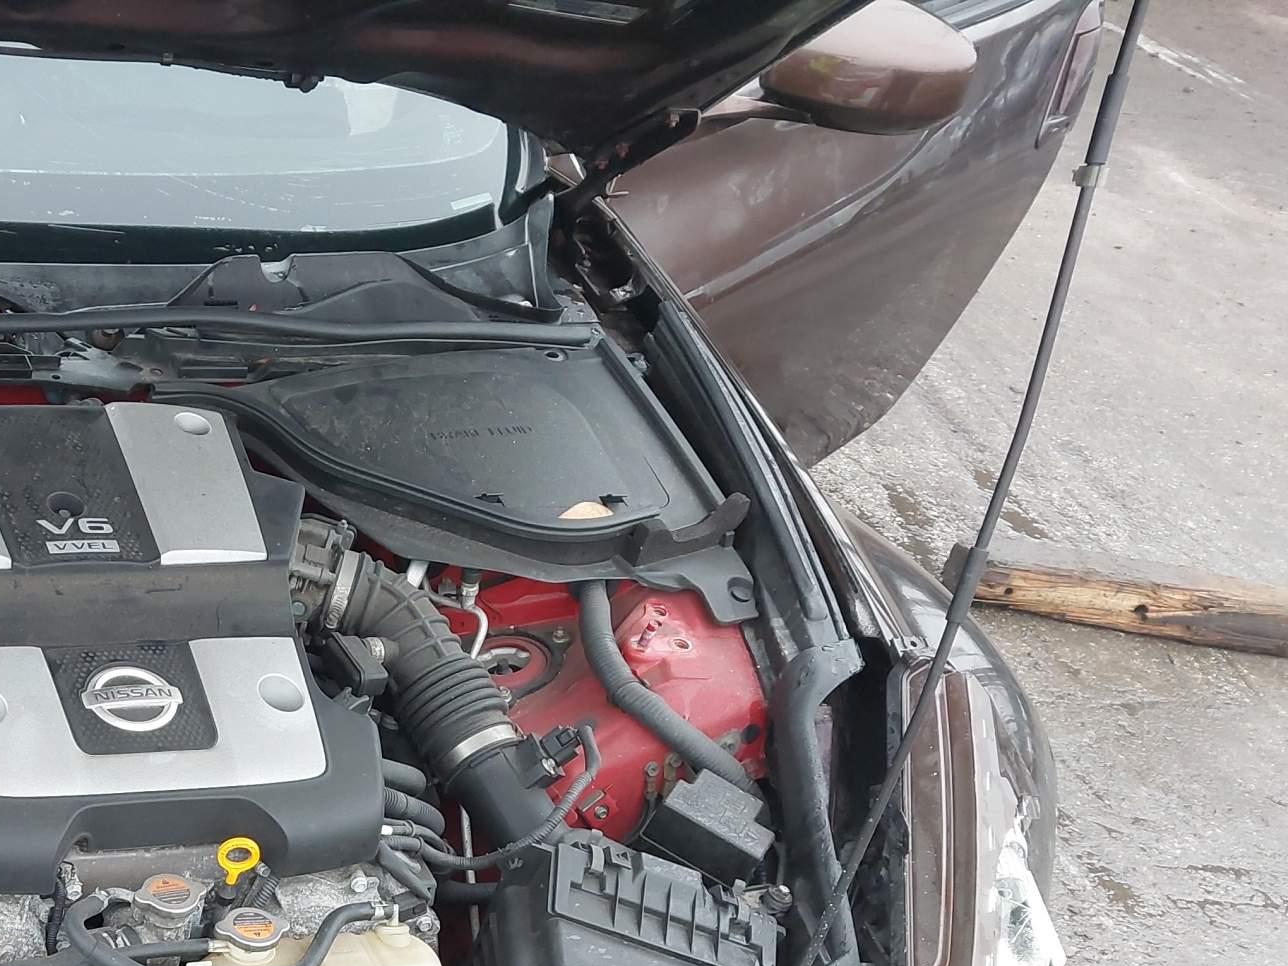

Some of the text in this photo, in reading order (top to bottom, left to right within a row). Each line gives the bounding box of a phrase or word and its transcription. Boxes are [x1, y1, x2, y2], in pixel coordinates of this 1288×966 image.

[35, 517, 114, 534] V6
[53, 543, 115, 551] VVEL
[94, 688, 173, 701] NISSAN
